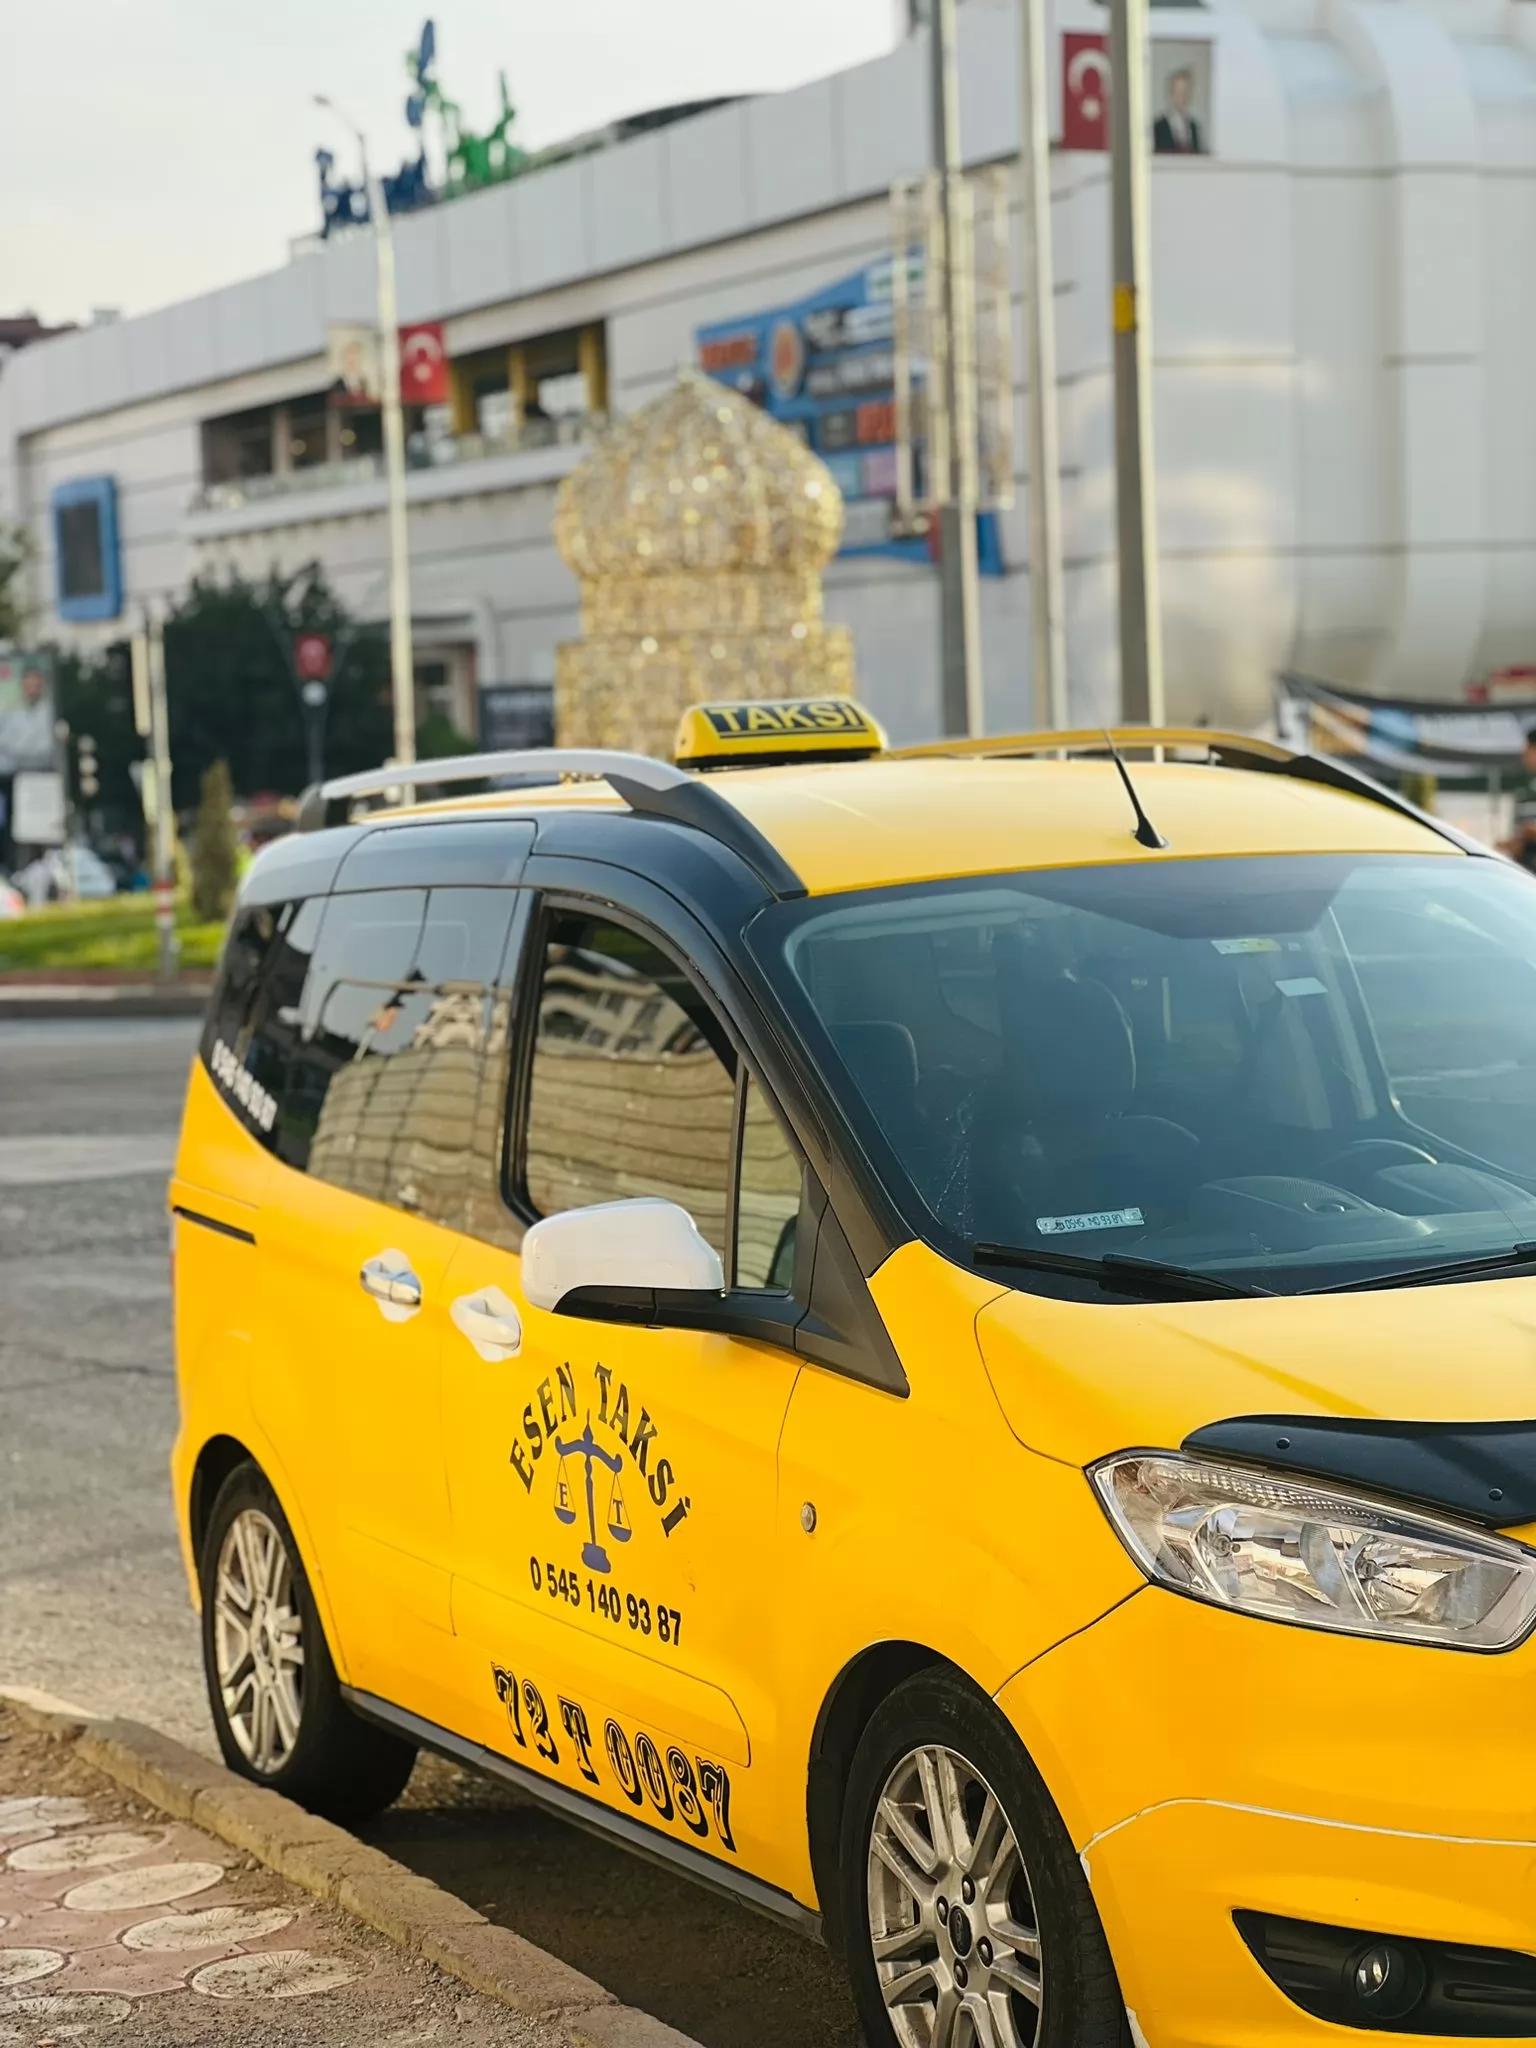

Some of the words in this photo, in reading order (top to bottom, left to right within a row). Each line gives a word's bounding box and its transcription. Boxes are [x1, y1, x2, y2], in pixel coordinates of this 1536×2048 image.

[510, 1361, 577, 1494] ESEN
[559, 1482, 569, 1507] E
[612, 1498, 623, 1525] T
[530, 1556, 542, 1591] 0
[546, 1562, 581, 1607] 545
[586, 1579, 622, 1623] 140
[626, 1593, 652, 1635] 93
[657, 1604, 682, 1647] 87
[490, 1661, 560, 1765] 72
[557, 1694, 600, 1786] T
[604, 1717, 737, 1854] 0087
